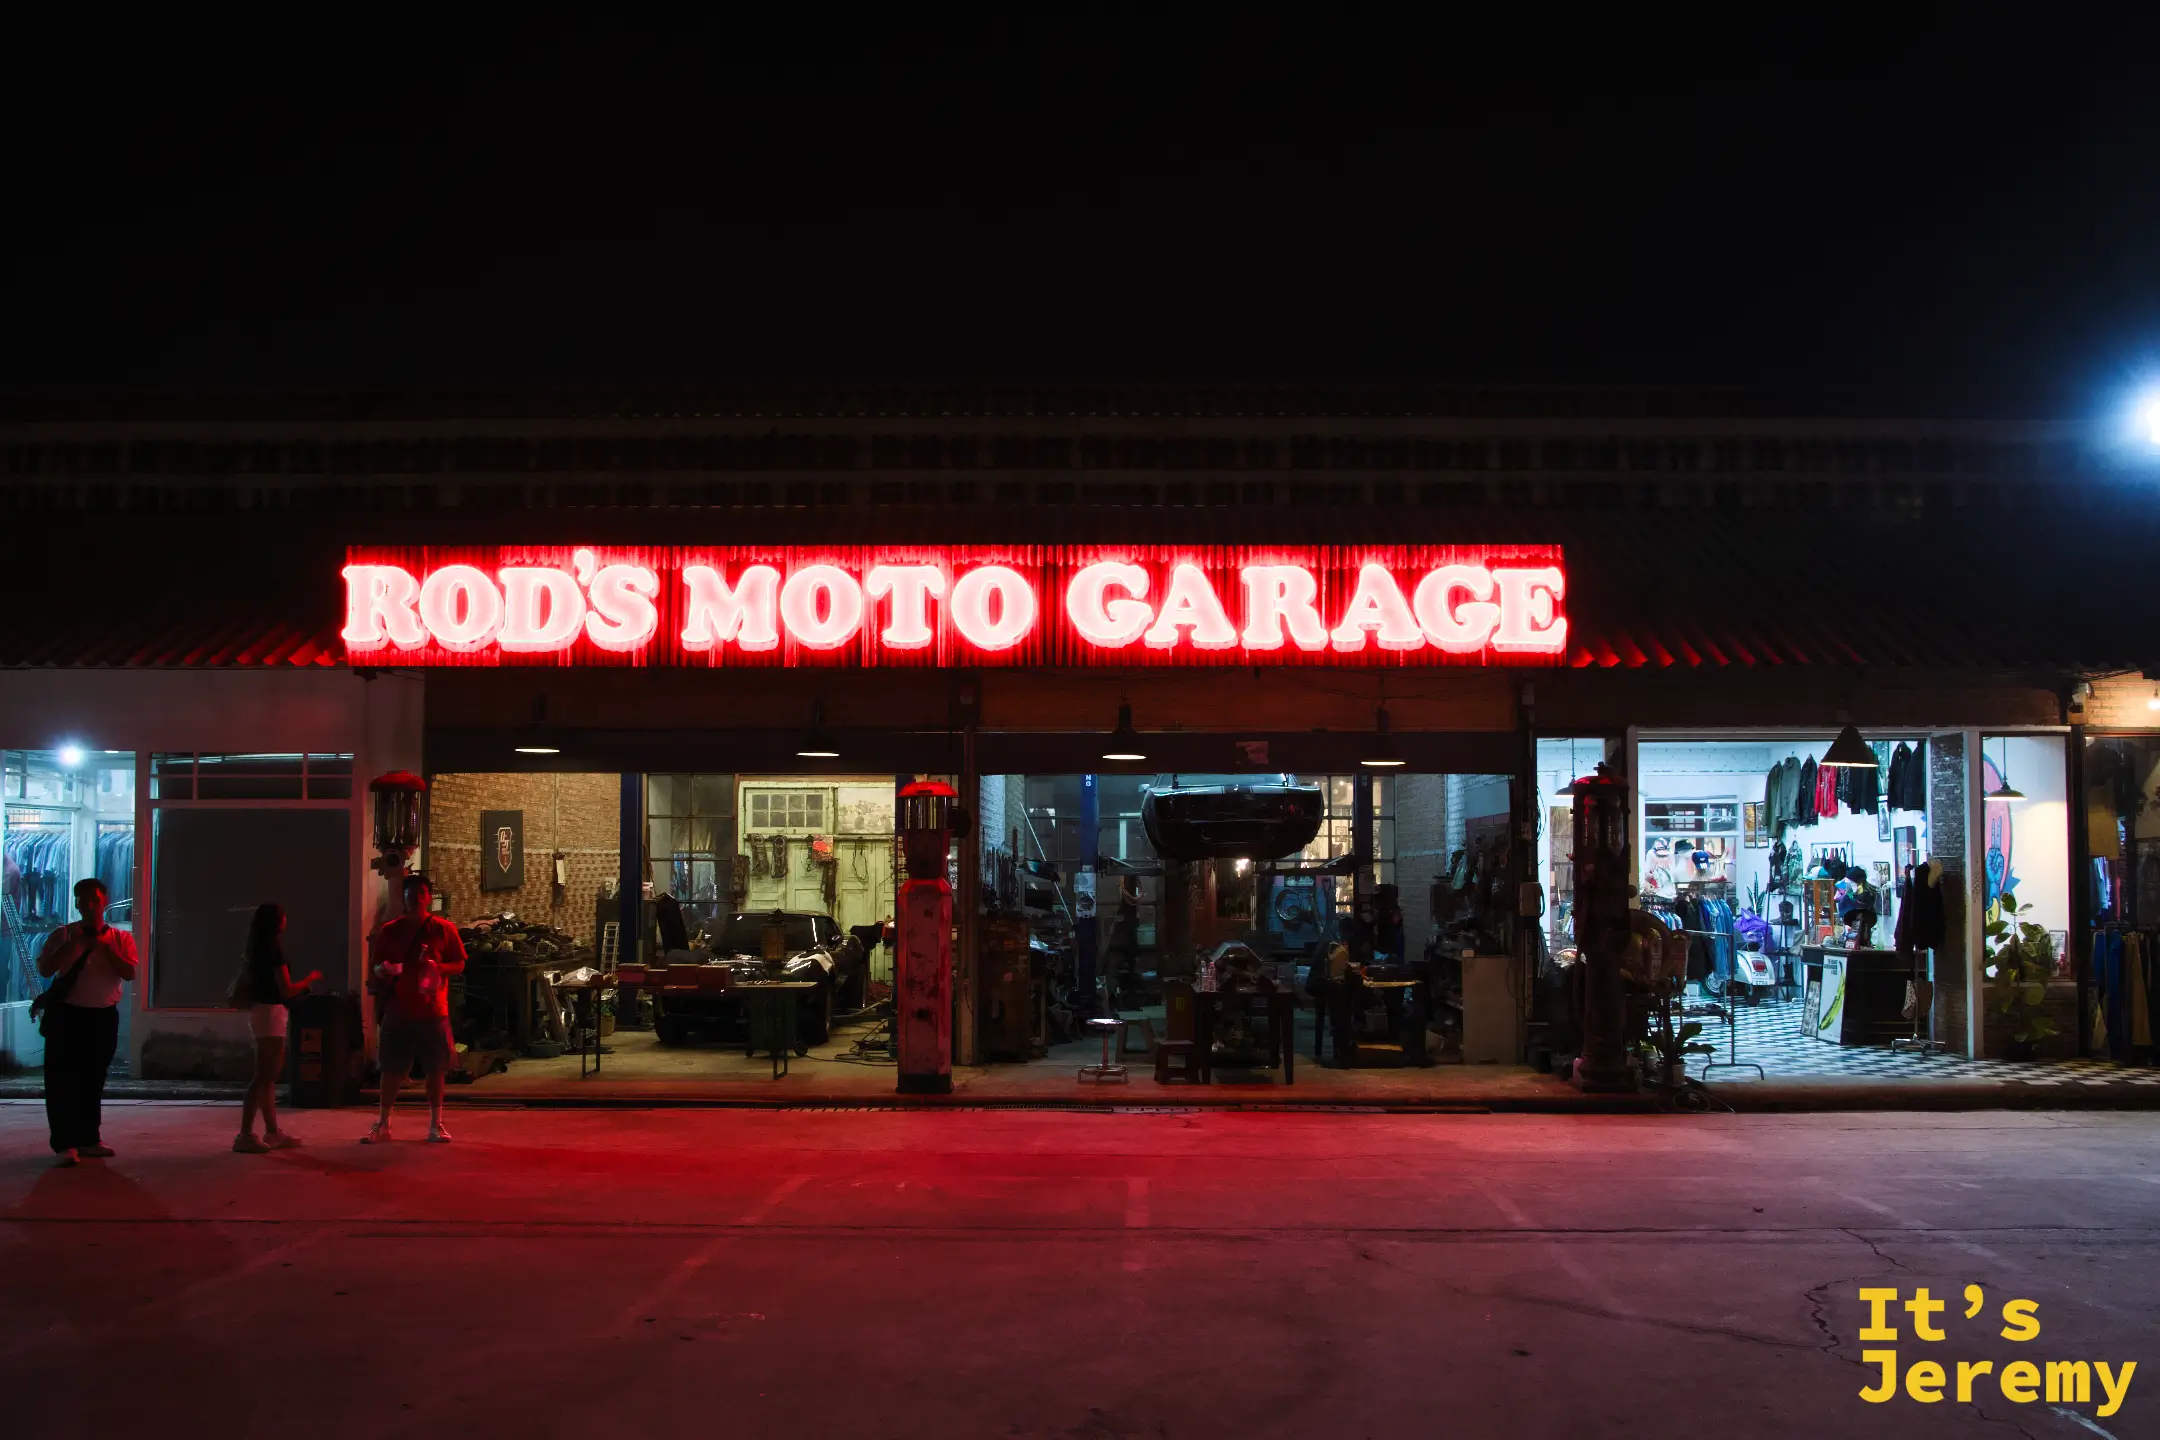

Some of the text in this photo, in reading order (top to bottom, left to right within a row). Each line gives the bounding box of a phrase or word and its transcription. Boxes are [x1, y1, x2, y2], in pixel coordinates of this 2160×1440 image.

[342, 548, 1568, 653] ROD'S MOTO GARAGE
